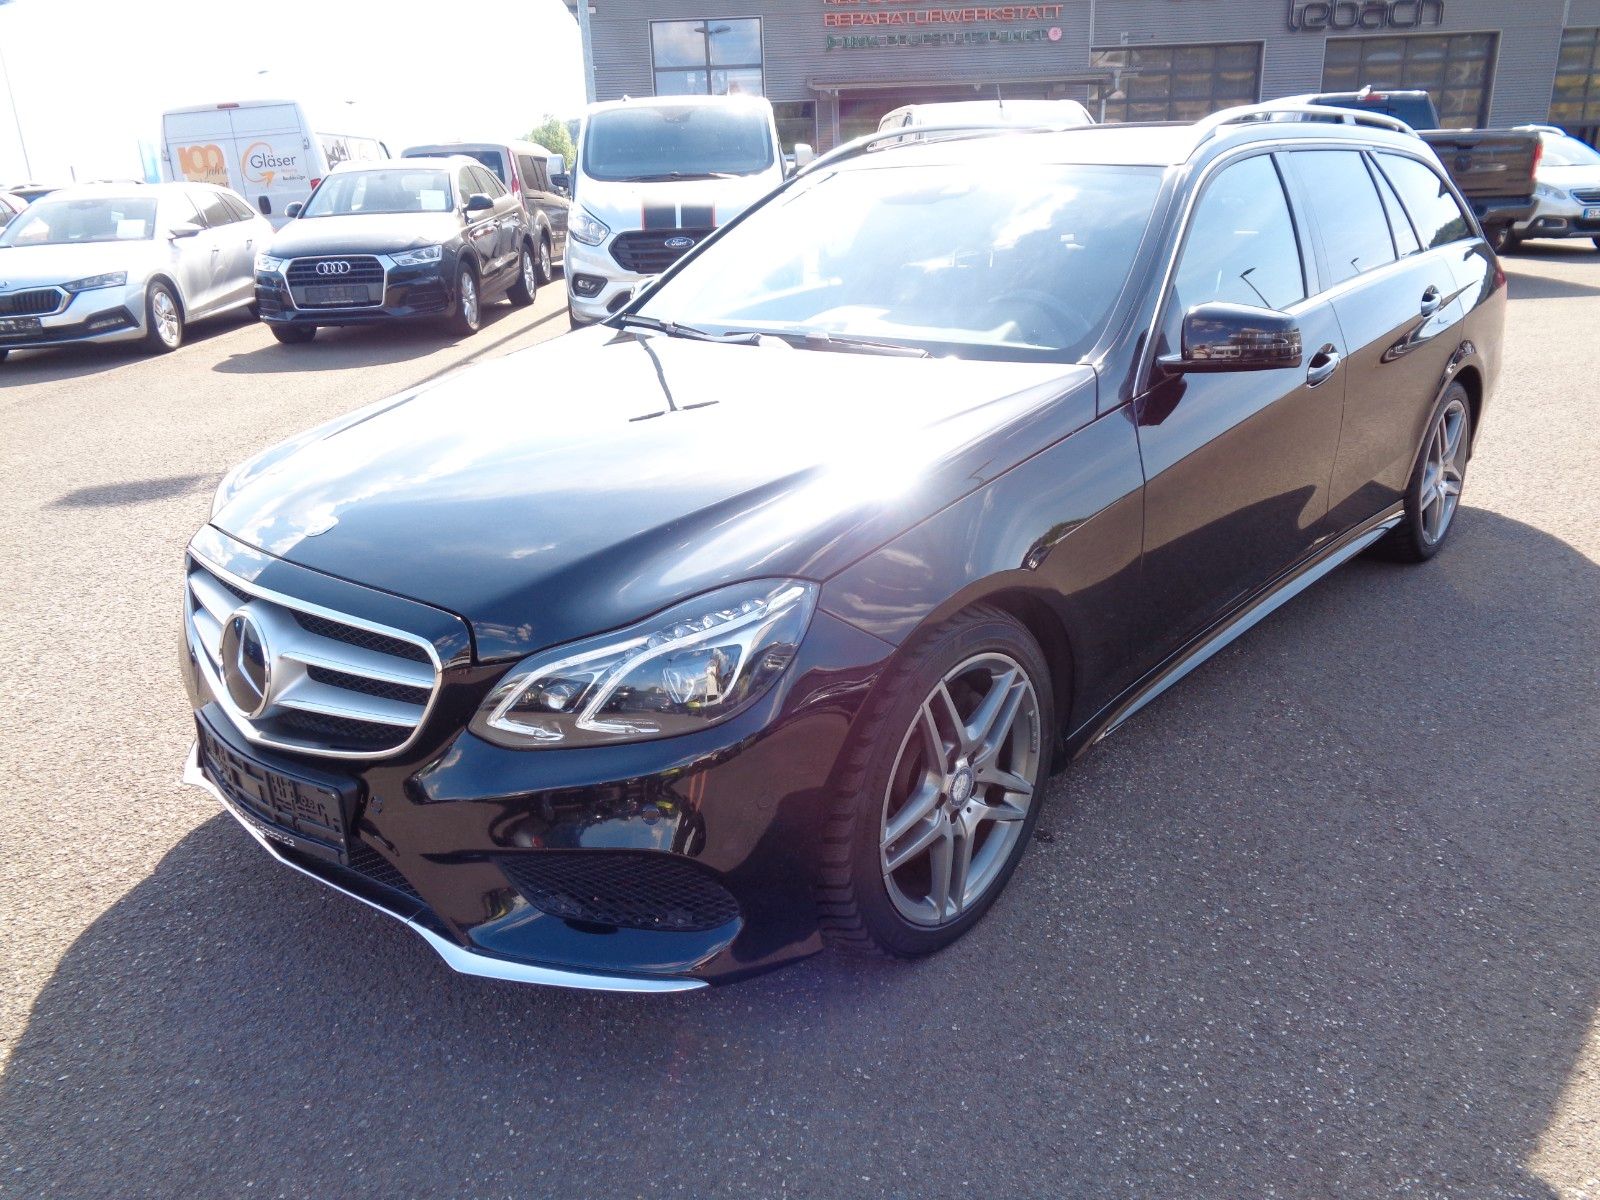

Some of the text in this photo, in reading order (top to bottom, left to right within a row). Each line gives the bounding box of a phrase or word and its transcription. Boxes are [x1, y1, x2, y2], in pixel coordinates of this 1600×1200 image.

[823, 4, 1064, 27] REPARATURWERKSTATT
[178, 144, 225, 175] 100
[250, 153, 296, 169] Gläser
